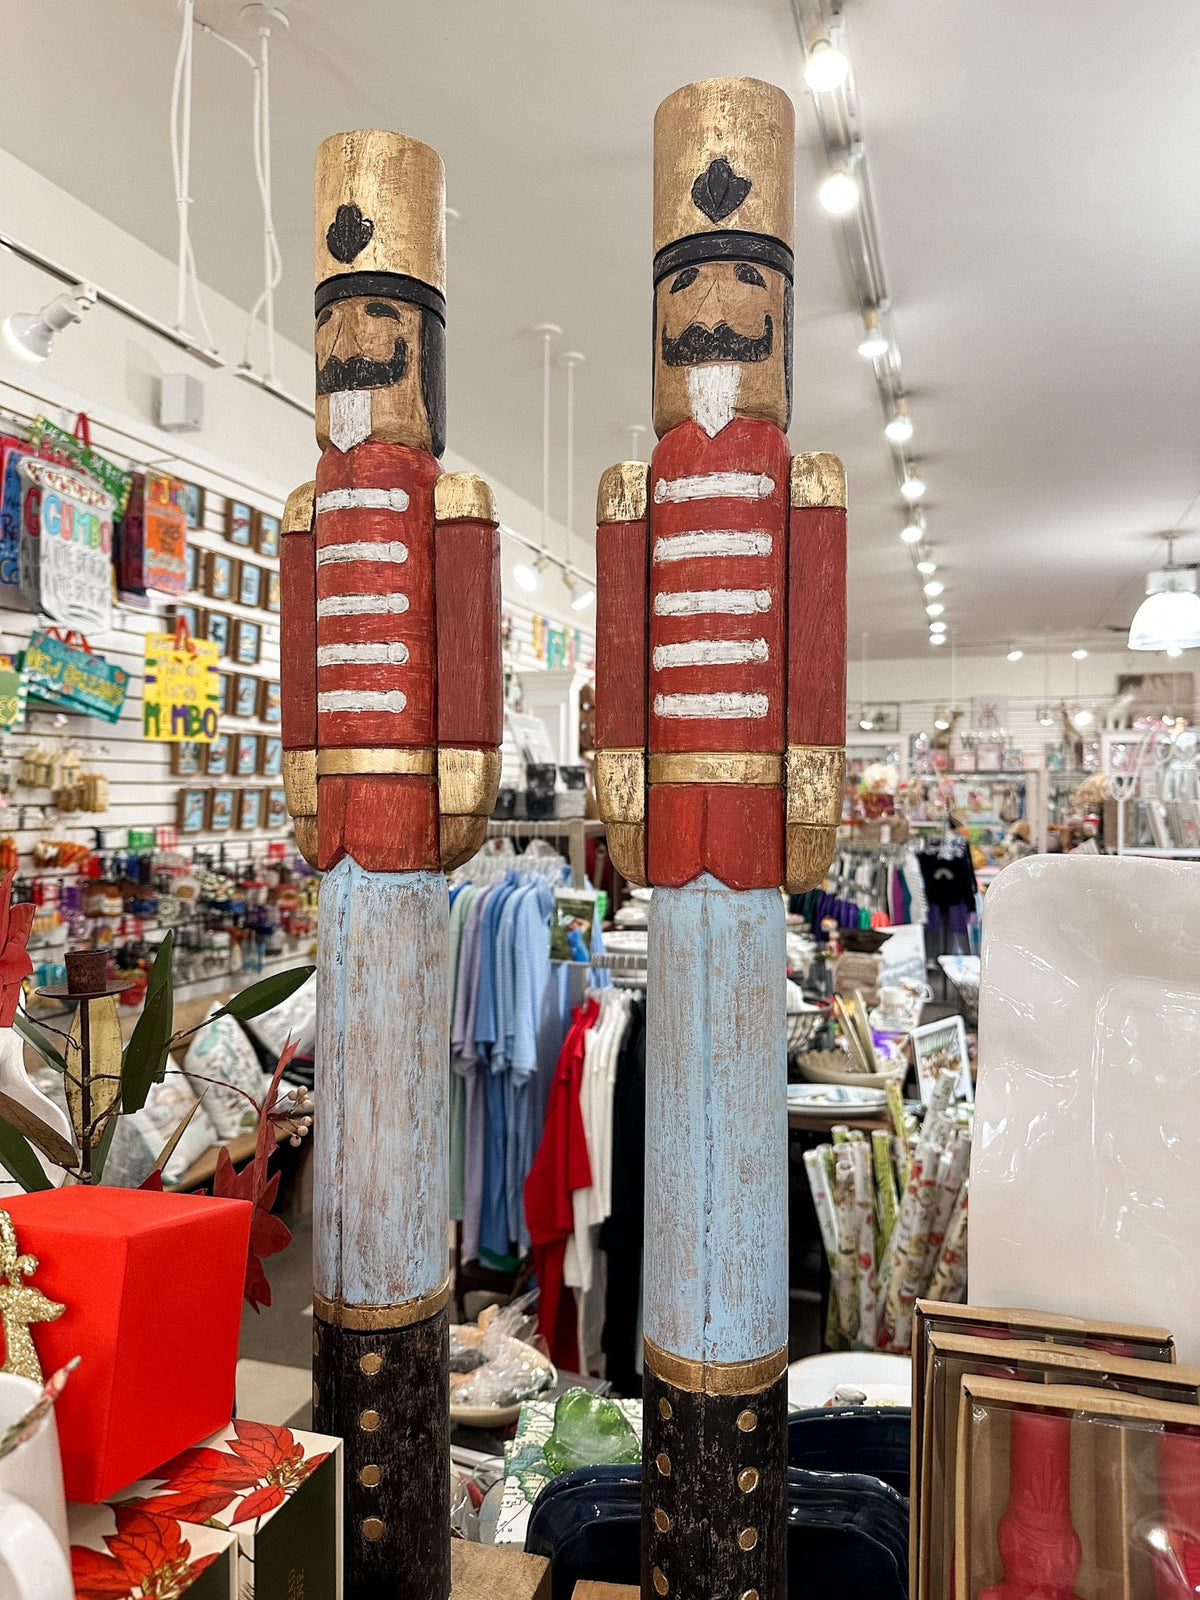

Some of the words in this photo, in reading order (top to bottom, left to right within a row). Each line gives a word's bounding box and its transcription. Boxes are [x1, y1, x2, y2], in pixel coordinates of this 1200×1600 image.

[44, 494, 112, 553] GUMBO
[27, 646, 62, 679] NEW
[62, 662, 123, 706] ORLEANS
